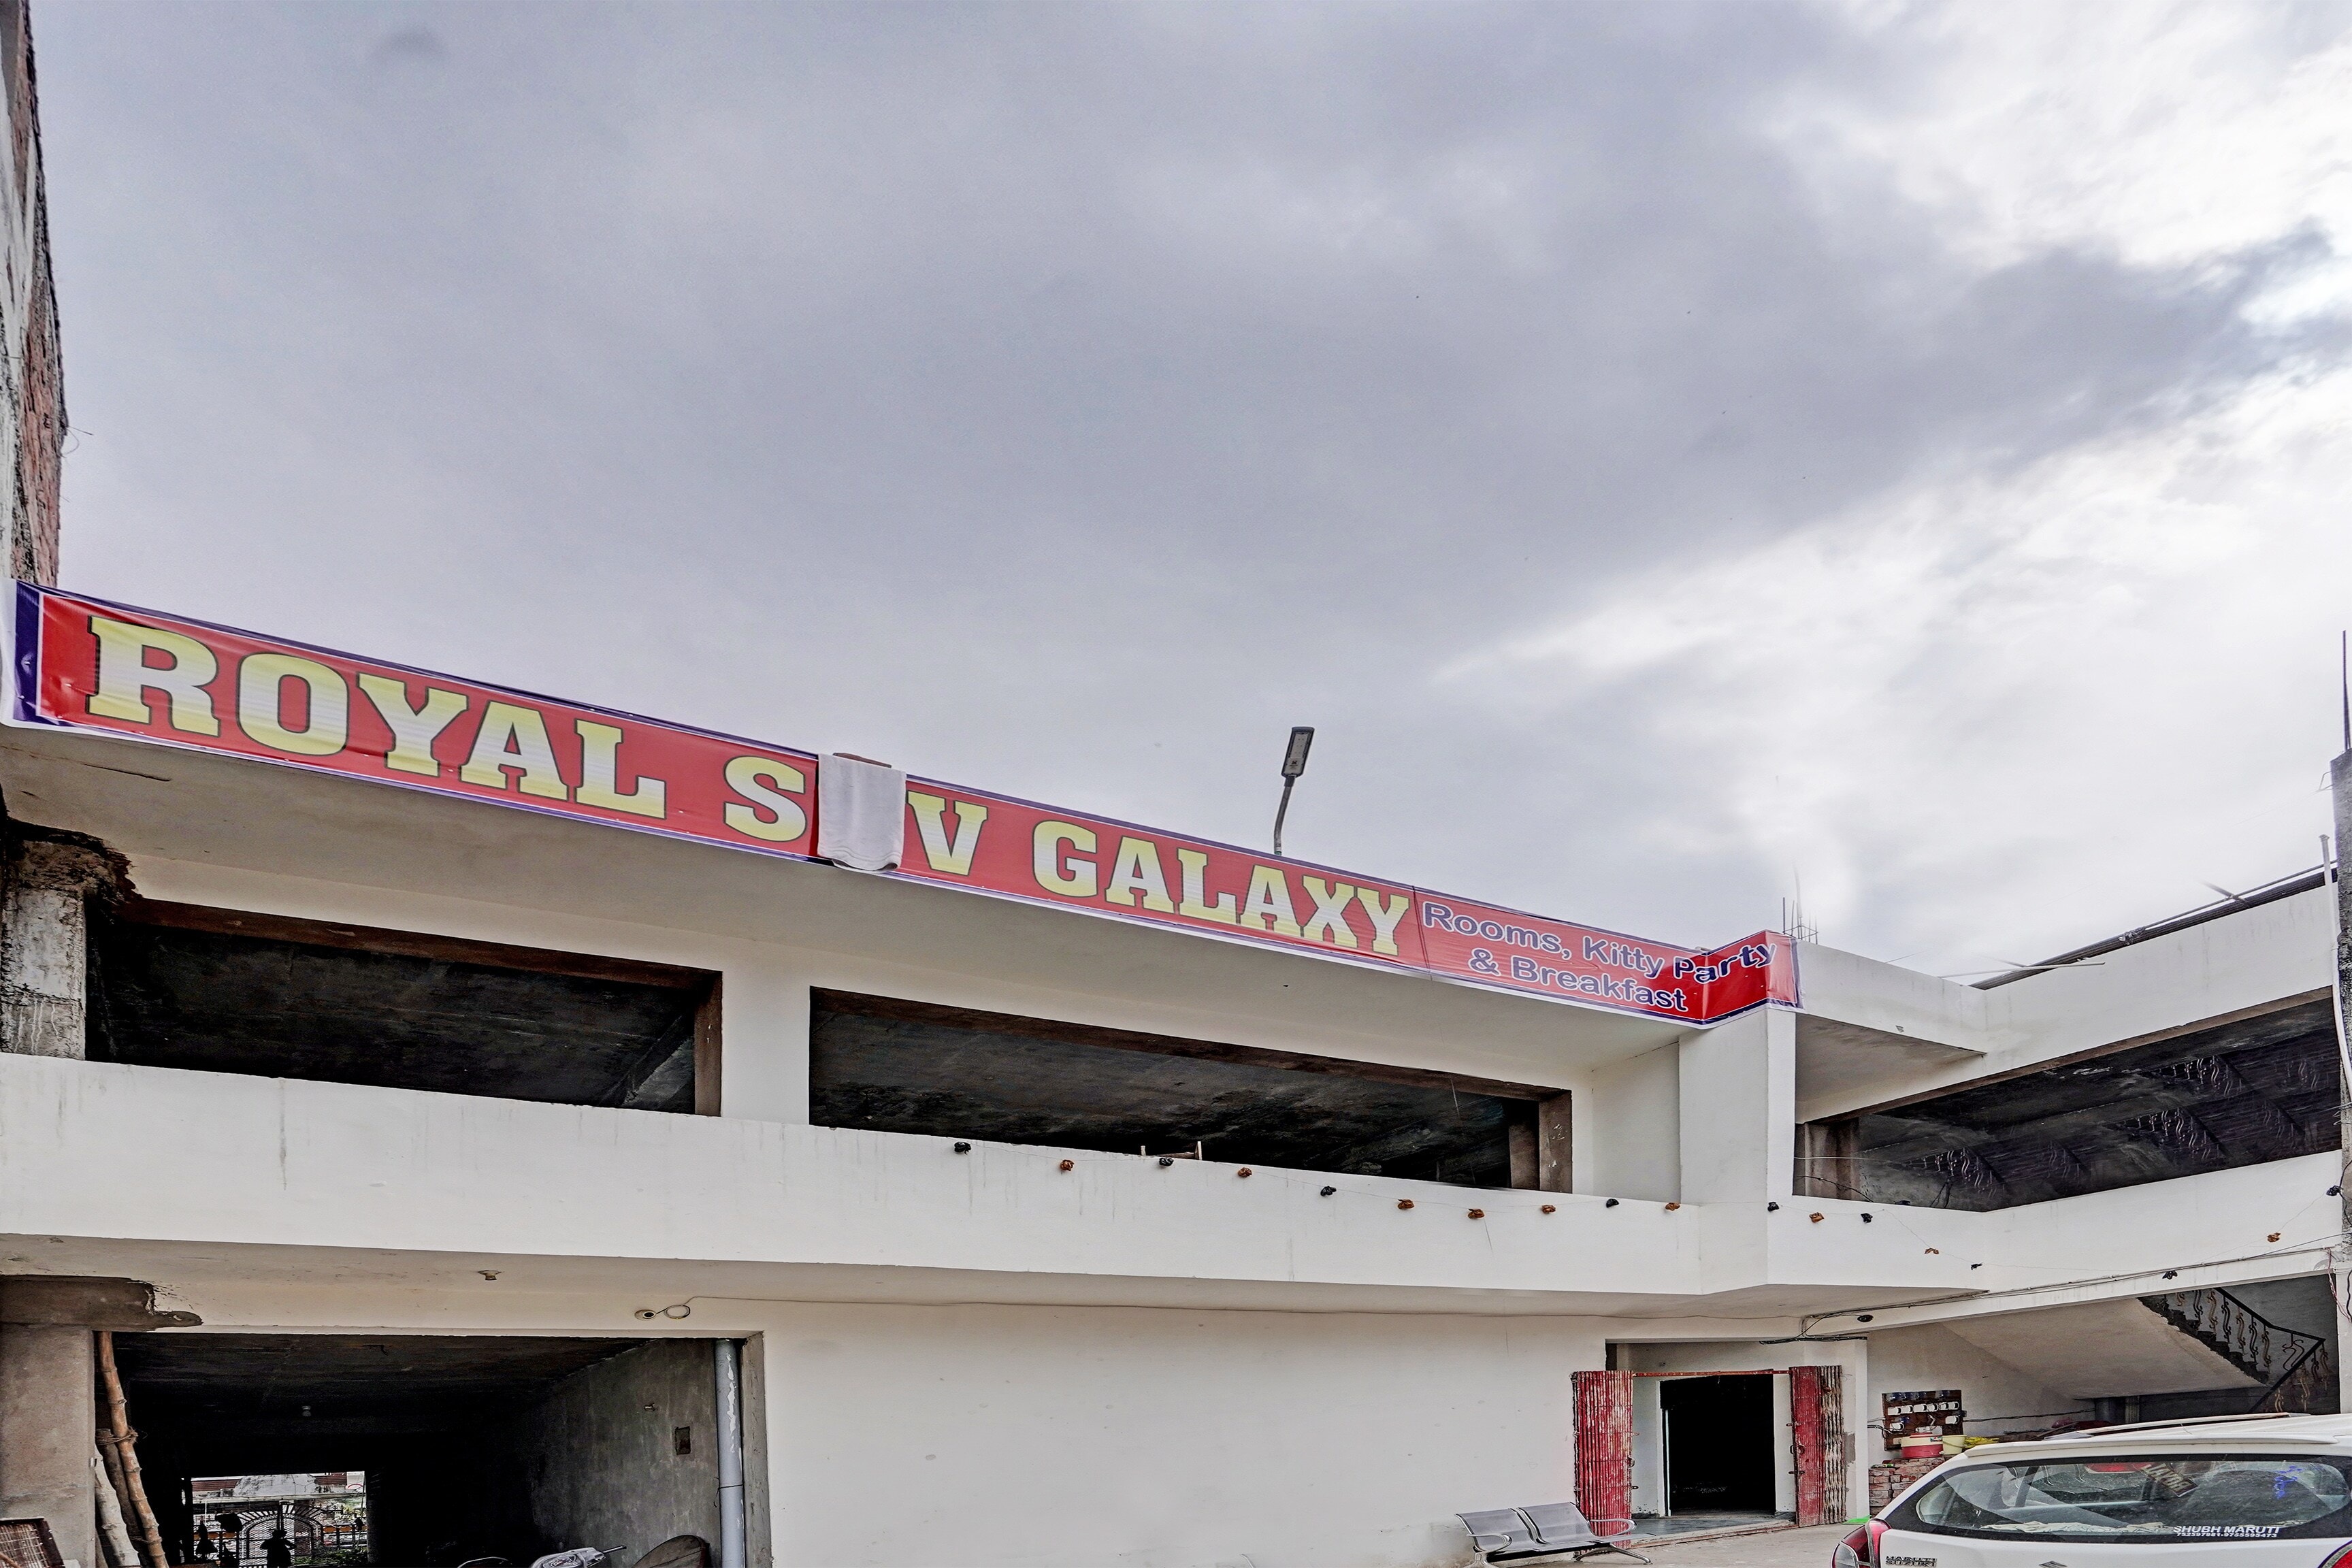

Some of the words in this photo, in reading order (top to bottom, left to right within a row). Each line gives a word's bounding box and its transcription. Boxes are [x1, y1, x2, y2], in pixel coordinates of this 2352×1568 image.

[86, 615, 666, 819] ROYAL
[1032, 819, 1410, 956] GALAXY
[1422, 900, 1571, 960] Rooms,
[1582, 935, 1665, 980] Kitty
[1672, 941, 1778, 985] Party
[1469, 947, 1501, 977] &
[1512, 955, 1689, 1013] Breakfast
[2173, 1525, 2221, 1533] SHUBH
[2223, 1526, 2280, 1534] MARUTI
